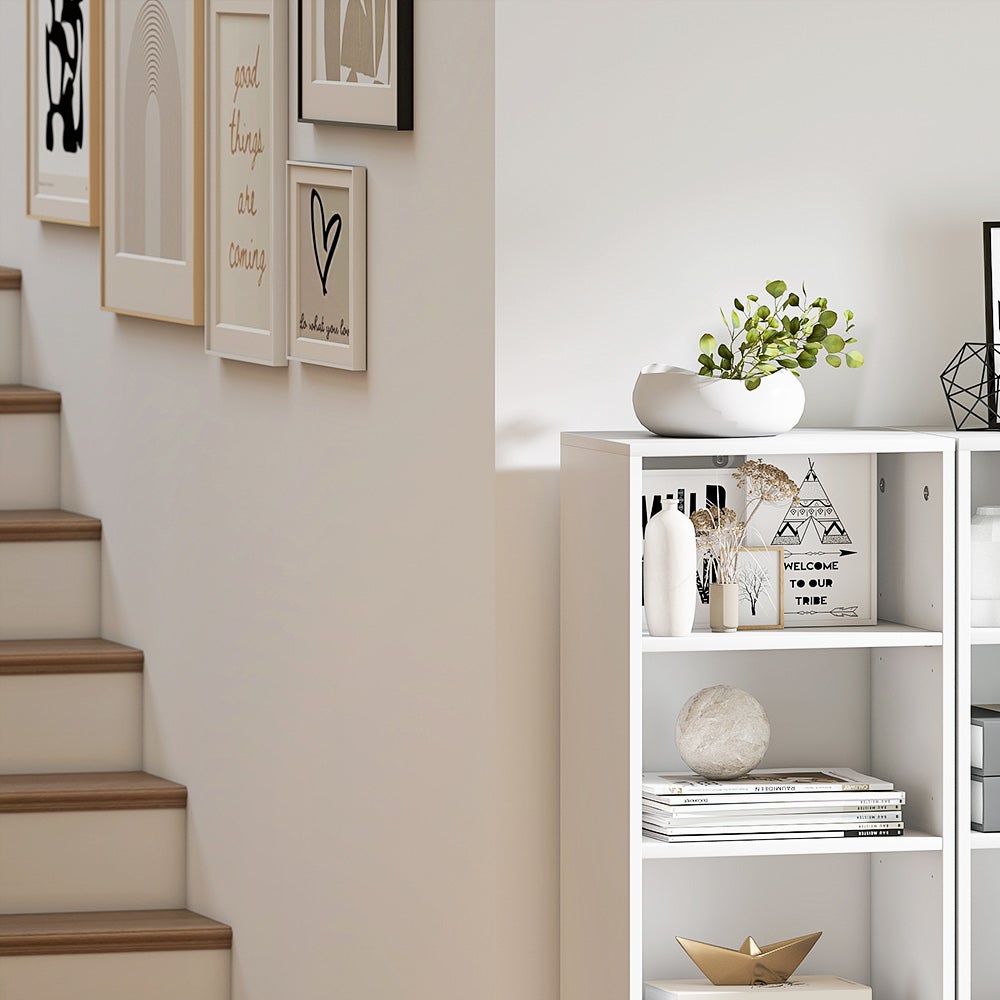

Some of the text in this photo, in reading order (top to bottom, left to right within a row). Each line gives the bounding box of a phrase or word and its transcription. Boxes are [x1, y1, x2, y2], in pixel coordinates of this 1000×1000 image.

[233, 43, 261, 104] good
[228, 107, 265, 171] things
[237, 183, 258, 217] are
[228, 238, 267, 287] coming
[308, 314, 325, 333] what
[325, 324, 339, 340] you
[783, 561, 839, 571] WELCOME
[789, 578, 833, 589] TO OUR
[795, 596, 828, 606] TRIBE
